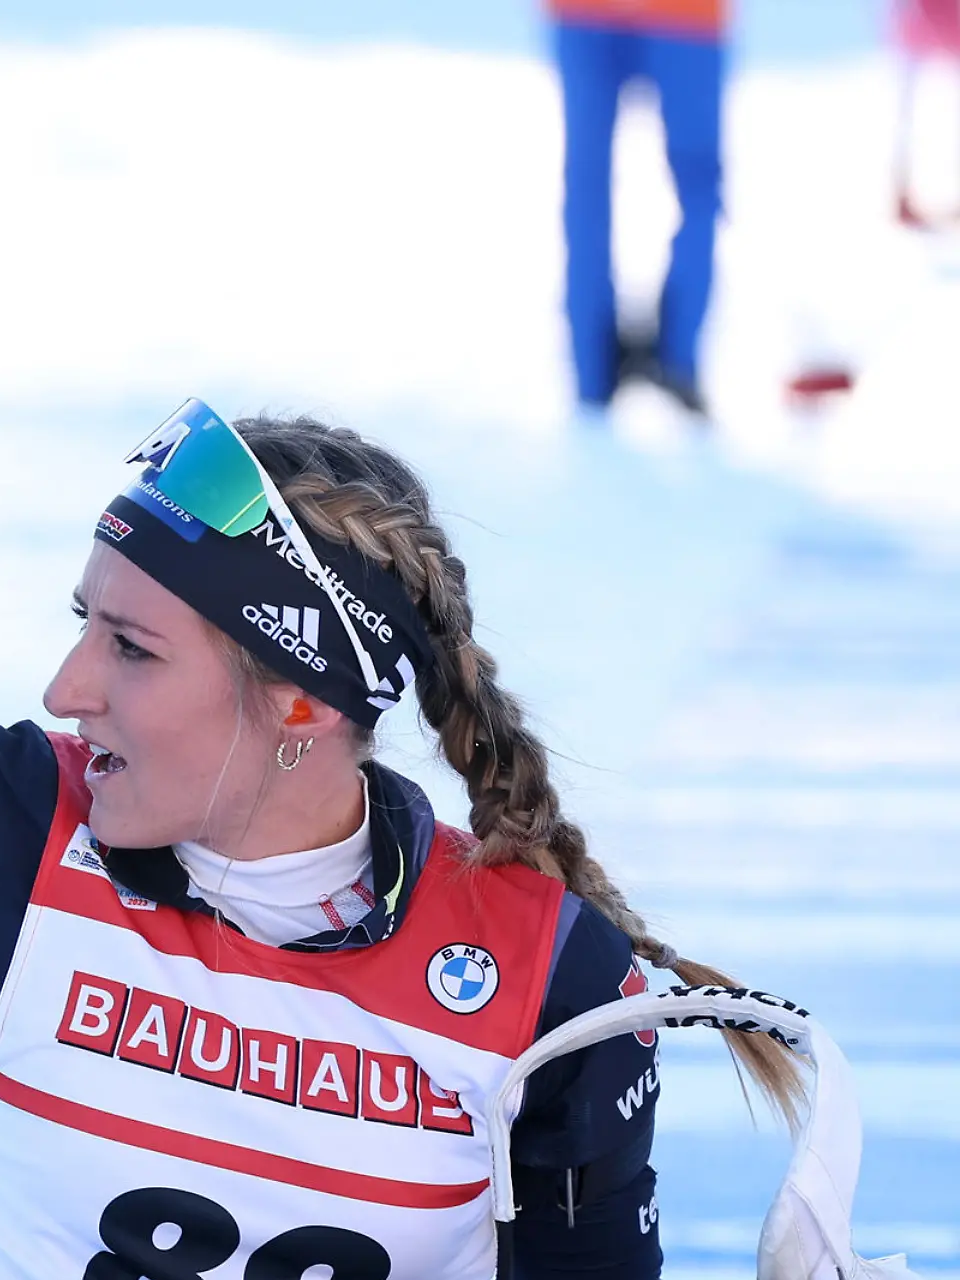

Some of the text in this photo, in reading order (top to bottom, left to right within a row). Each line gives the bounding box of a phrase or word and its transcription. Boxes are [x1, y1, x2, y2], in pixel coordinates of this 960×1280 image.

[250, 519, 394, 643] Meditrade
[241, 603, 328, 673] adidas
[441, 947, 494, 970] BMW
